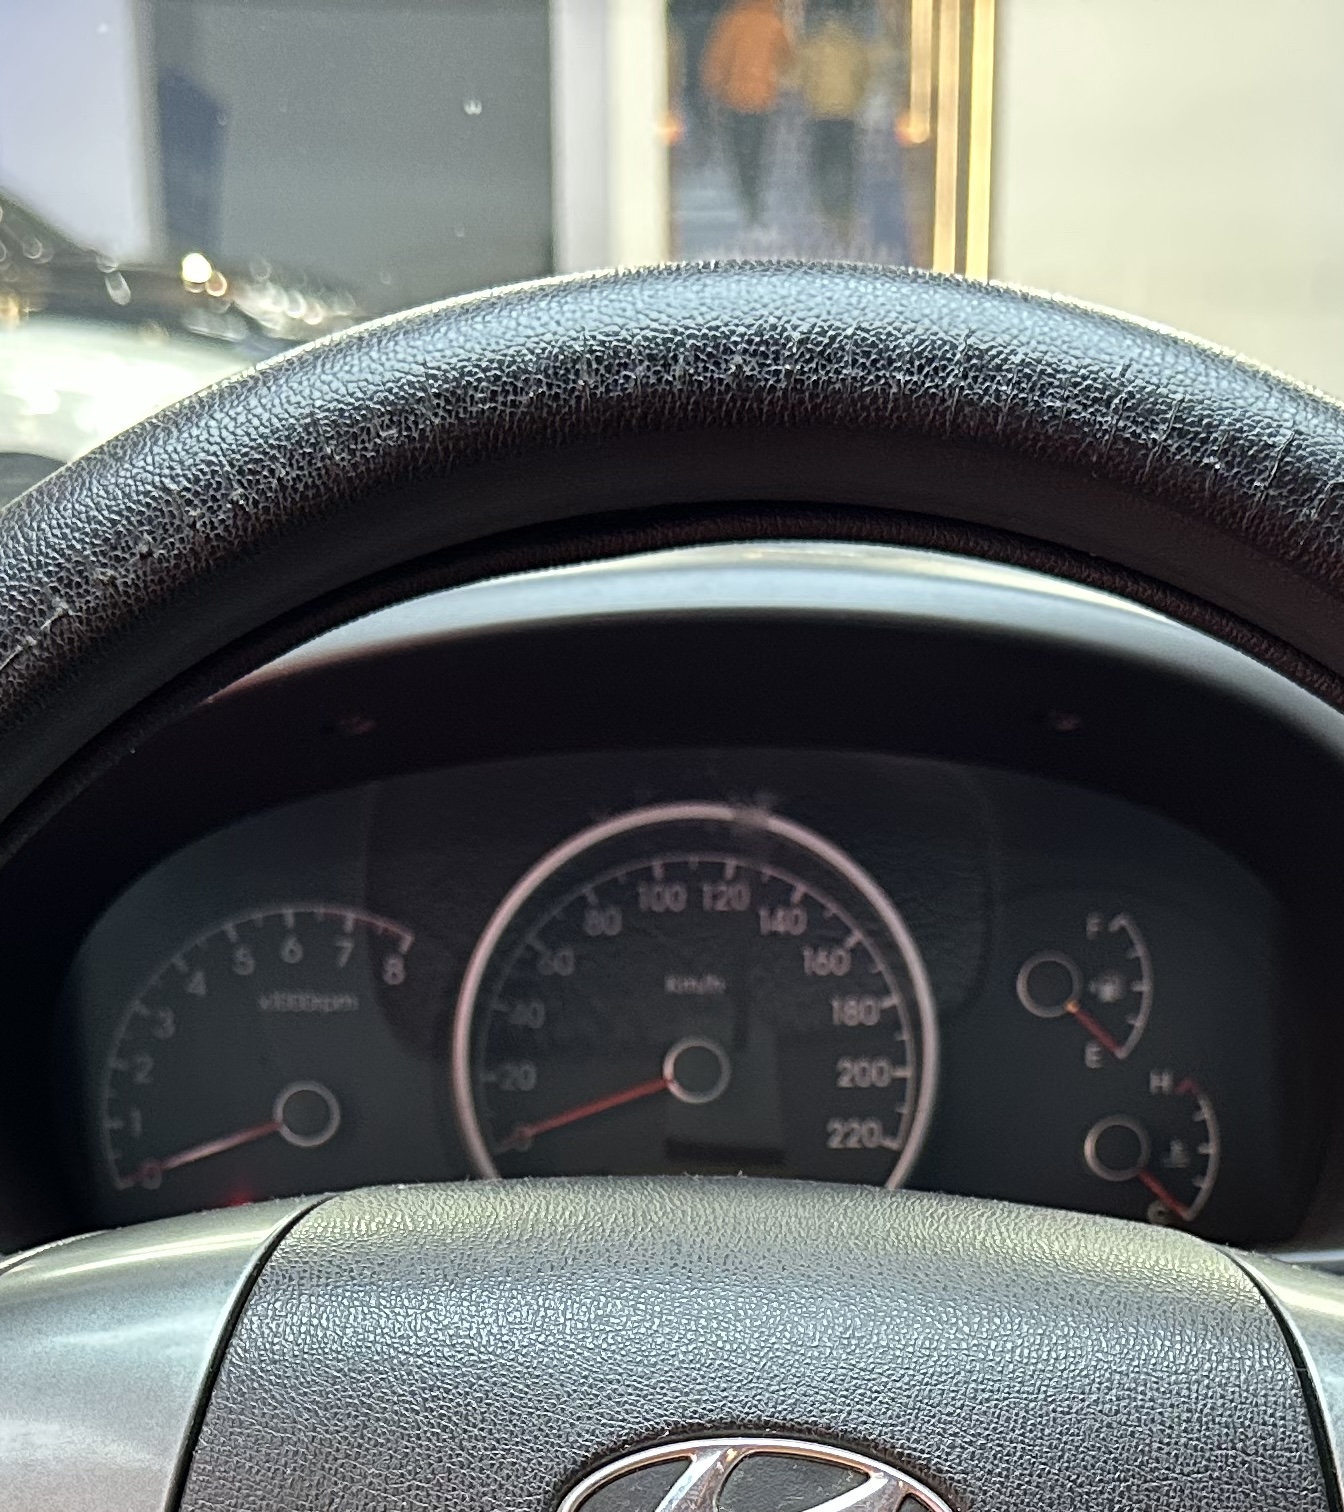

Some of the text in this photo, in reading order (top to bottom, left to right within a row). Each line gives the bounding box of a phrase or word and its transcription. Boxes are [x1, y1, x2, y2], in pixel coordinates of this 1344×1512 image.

[638, 882, 688, 912] 100
[702, 882, 752, 912] 120
[584, 906, 623, 936] 80
[759, 907, 808, 936] 140
[280, 936, 304, 964] 6
[335, 940, 353, 969] 7
[803, 947, 851, 976] 160
[381, 955, 407, 986] 8
[832, 998, 881, 1027] 180
[836, 1058, 891, 1089] 200
[827, 1120, 883, 1150] 220
